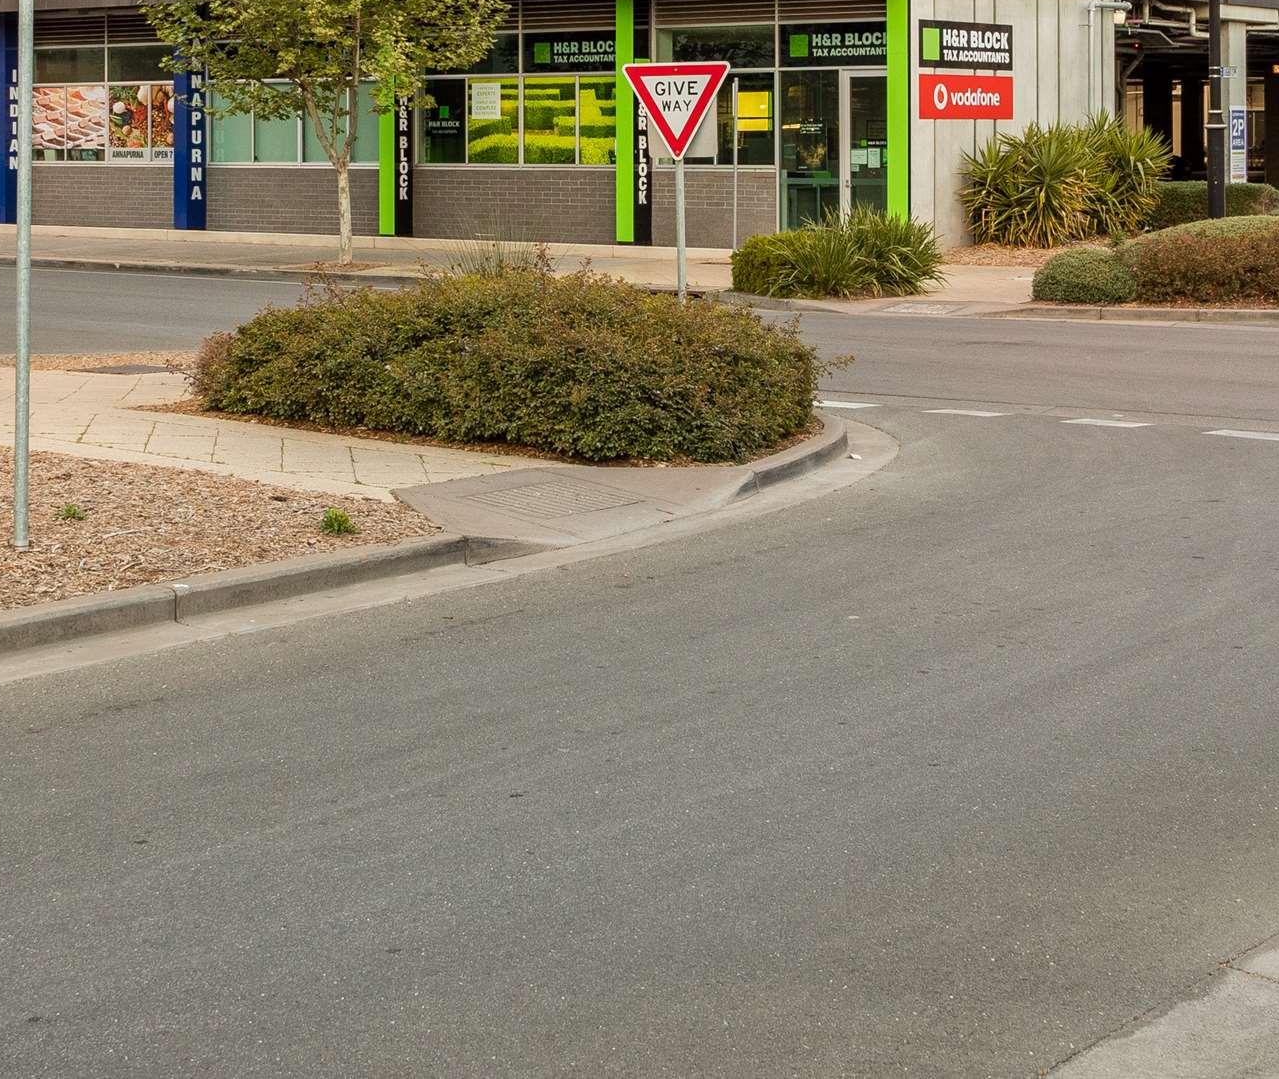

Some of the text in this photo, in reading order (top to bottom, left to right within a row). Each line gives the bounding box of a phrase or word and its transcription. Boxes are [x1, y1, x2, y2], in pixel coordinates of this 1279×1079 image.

[812, 33, 841, 46] H&R
[942, 28, 1009, 50] H&R BLOCK
[553, 40, 616, 54] H&R BLOC
[812, 47, 887, 57] TAX ACCOUNTANT
[553, 55, 568, 63] TAX
[943, 49, 1010, 64] TAX ACCOUNTANTS
[654, 81, 698, 96] GIVE
[951, 88, 1001, 106] vodafone
[661, 100, 692, 112] WAY
[9, 69, 18, 170] INDIAN
[1232, 119, 1244, 136] 2P
[112, 150, 144, 158] ANNAPURNA
[154, 150, 168, 158] OPEN
[638, 102, 647, 205] &R BLOCK
[399, 136, 408, 200] BLOCK
